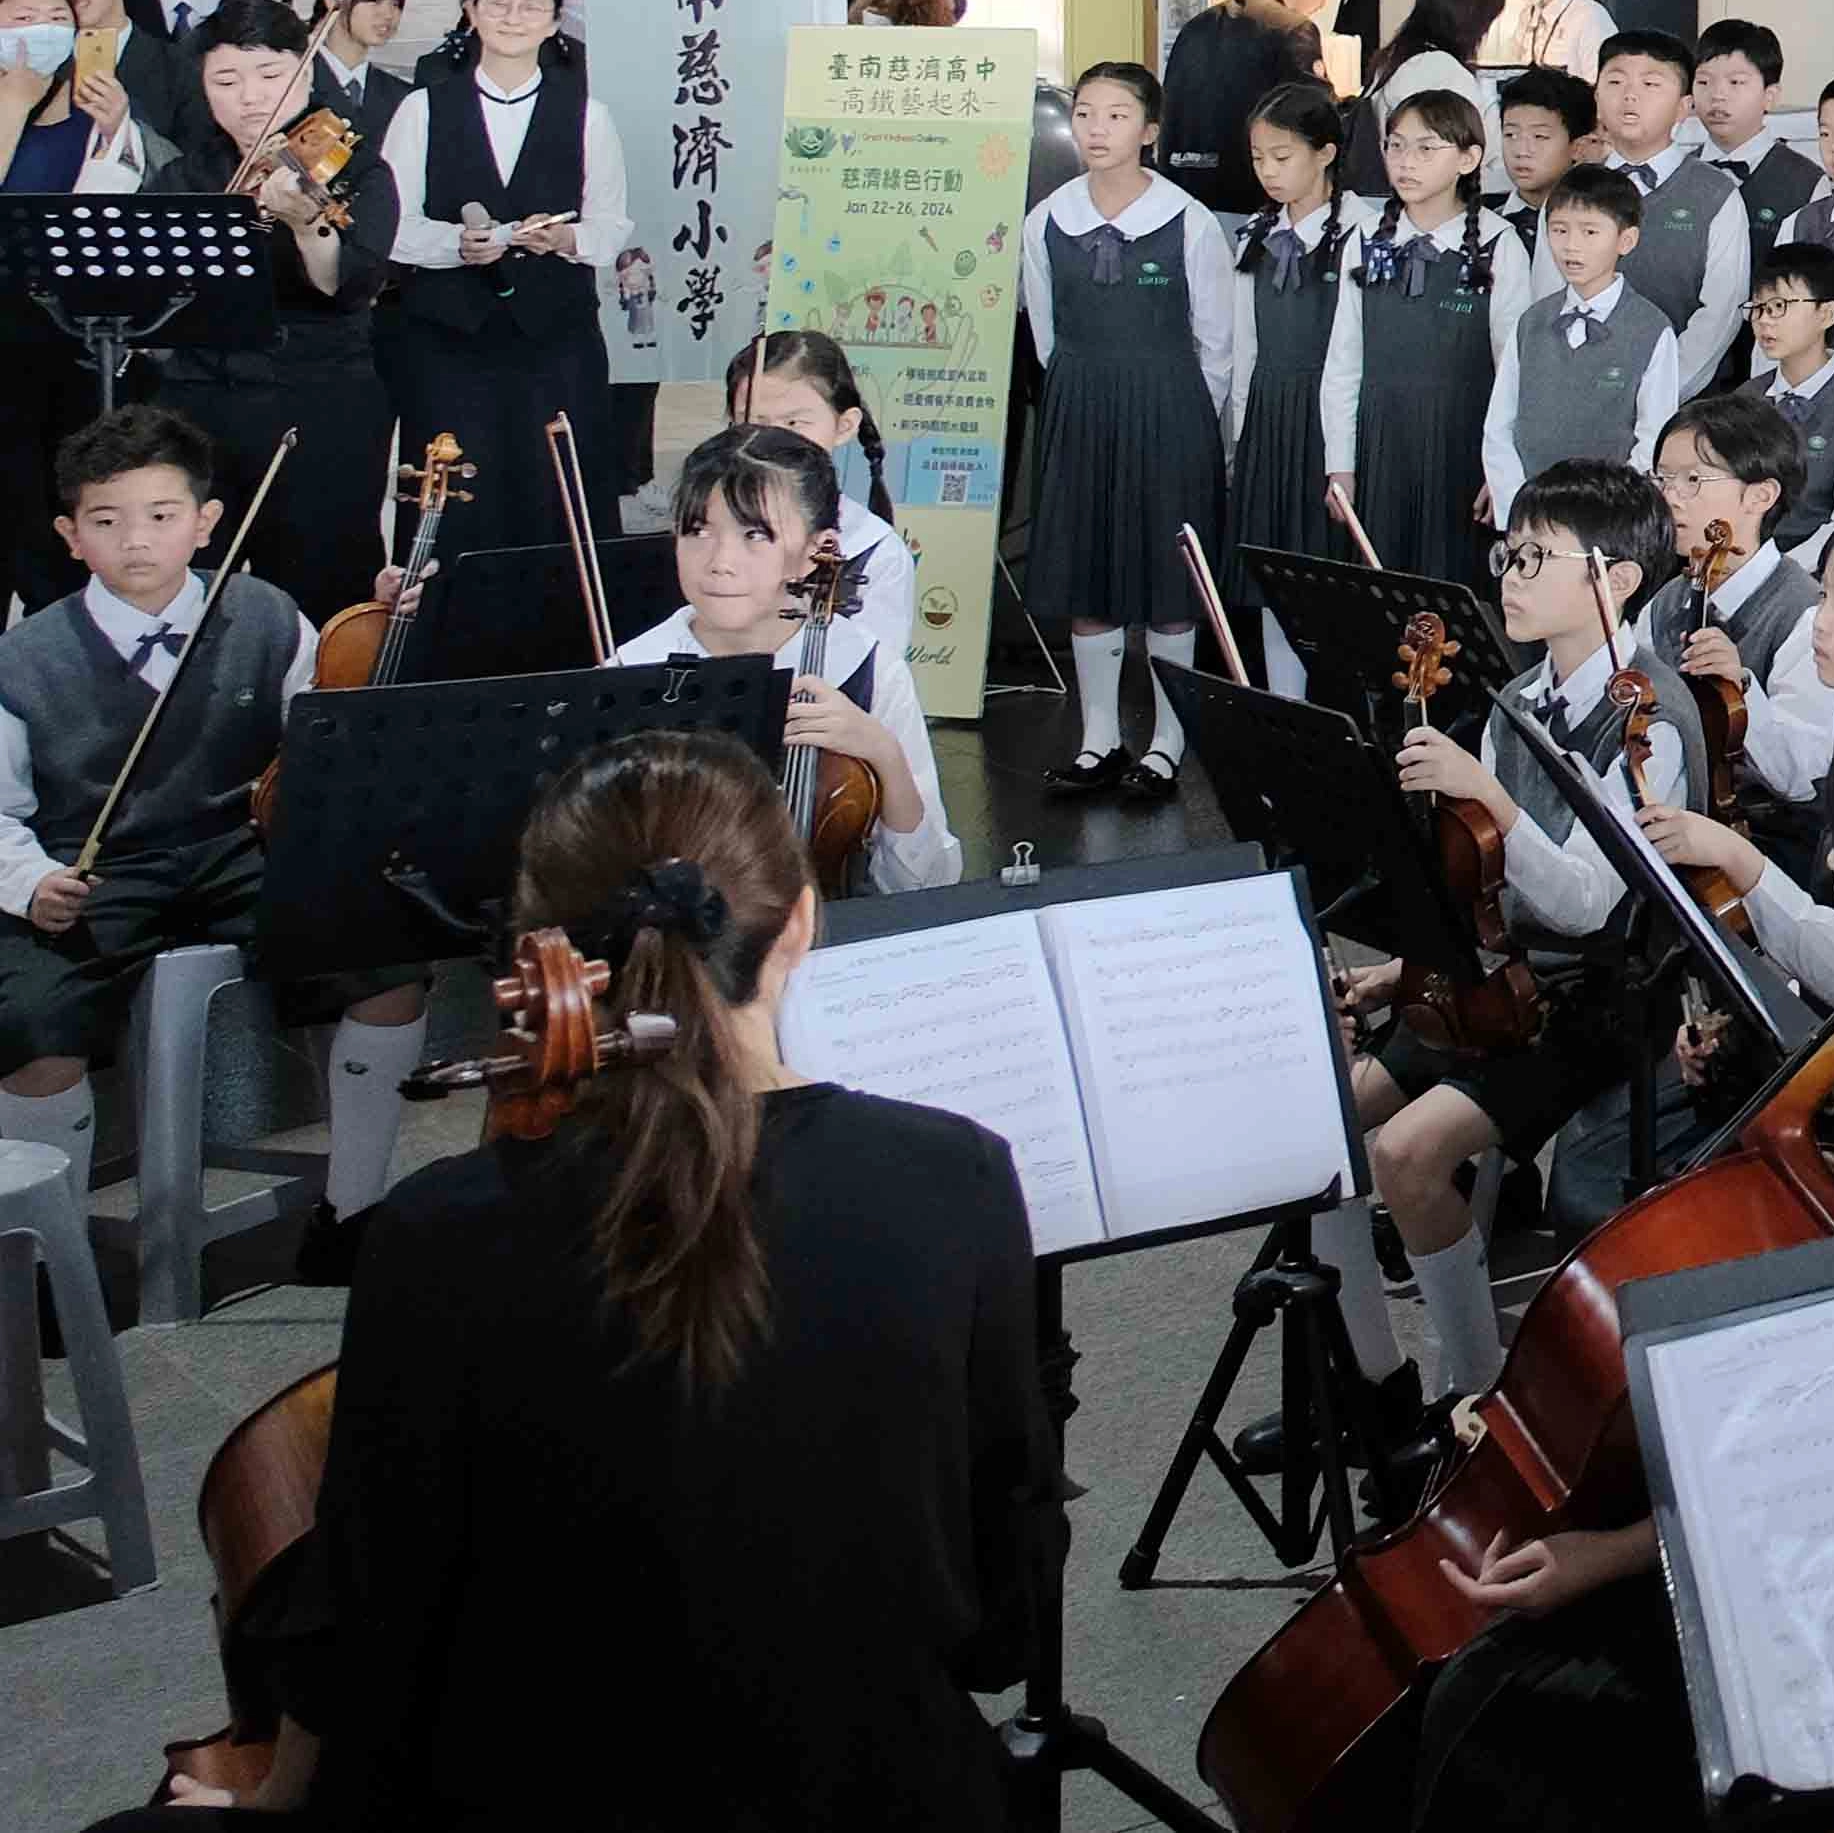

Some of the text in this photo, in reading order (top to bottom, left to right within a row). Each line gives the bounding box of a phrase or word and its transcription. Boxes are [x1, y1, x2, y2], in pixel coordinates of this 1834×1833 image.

[828, 53, 997, 83] 臺南慈濟高中
[844, 200, 868, 215] Jan
[920, 201, 953, 216] 2024
